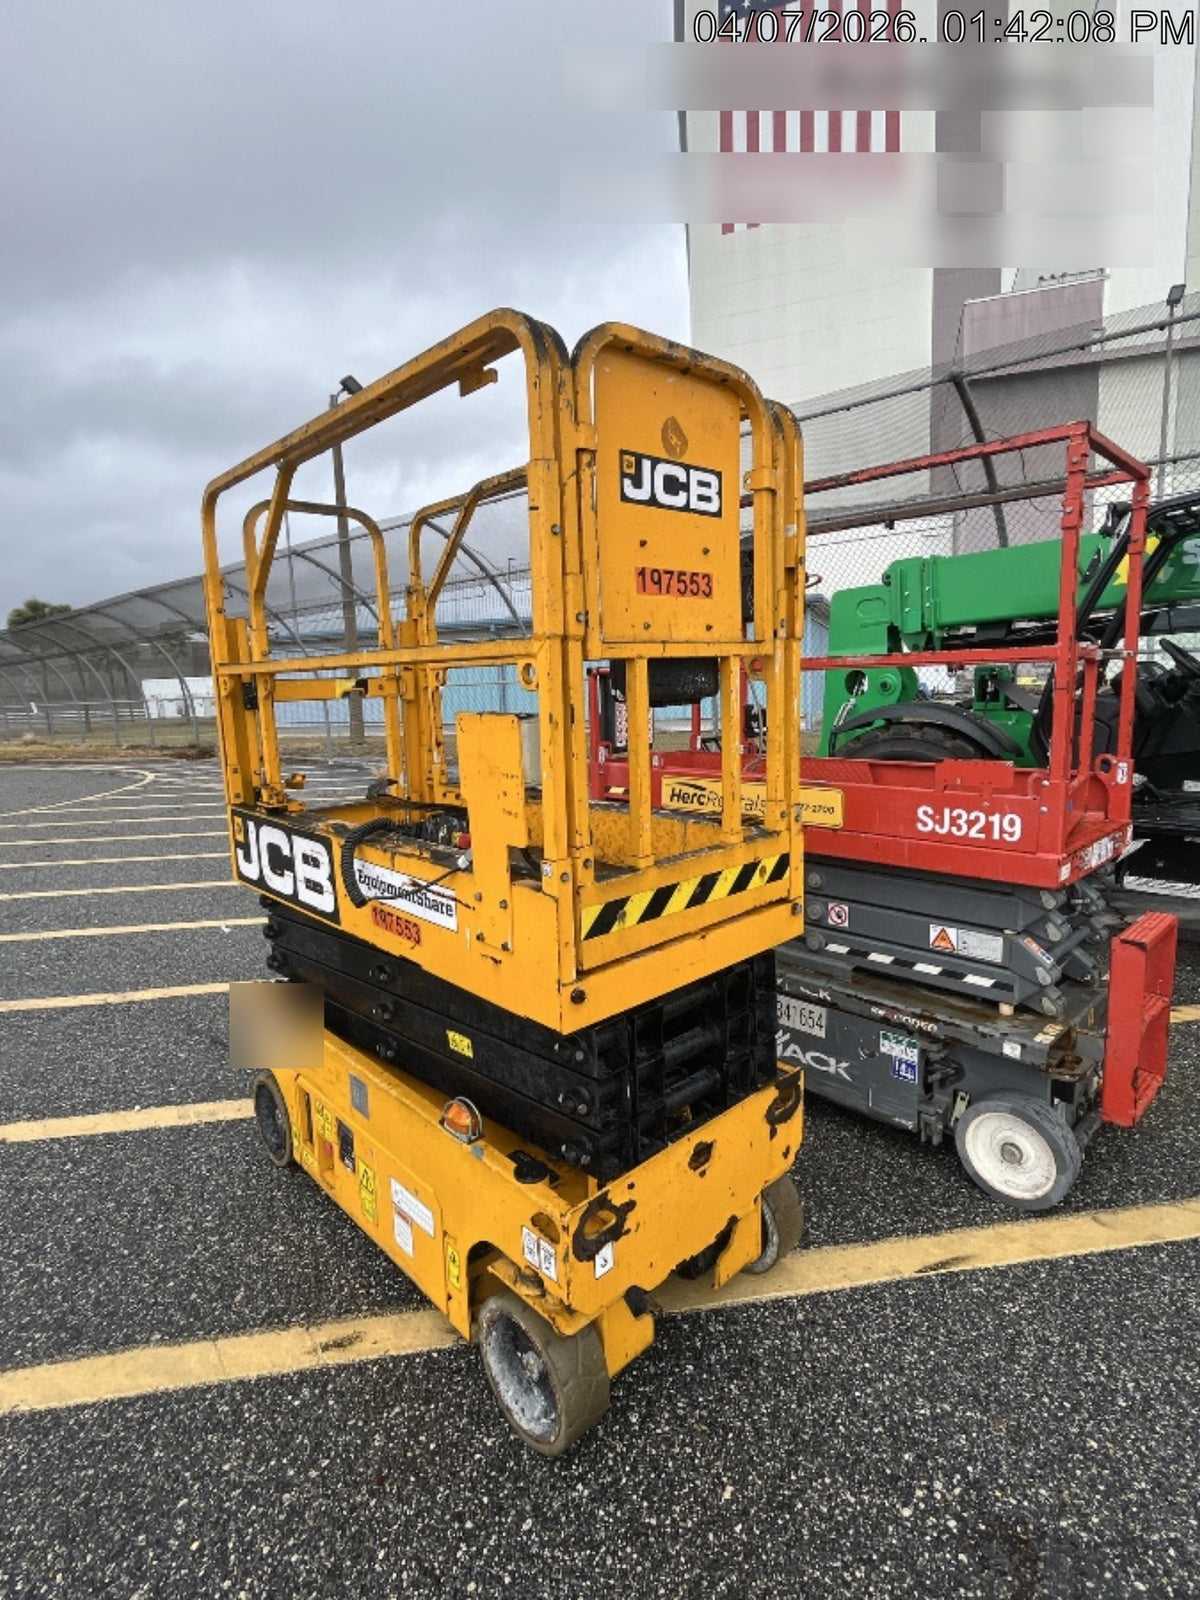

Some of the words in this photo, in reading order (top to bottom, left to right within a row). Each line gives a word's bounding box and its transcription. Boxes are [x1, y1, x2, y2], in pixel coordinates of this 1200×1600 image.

[623, 458, 721, 513] JCB
[637, 567, 712, 598] 197553
[916, 805, 1022, 842] SJ3219
[236, 820, 336, 913] JCB
[372, 906, 421, 945] 197553
